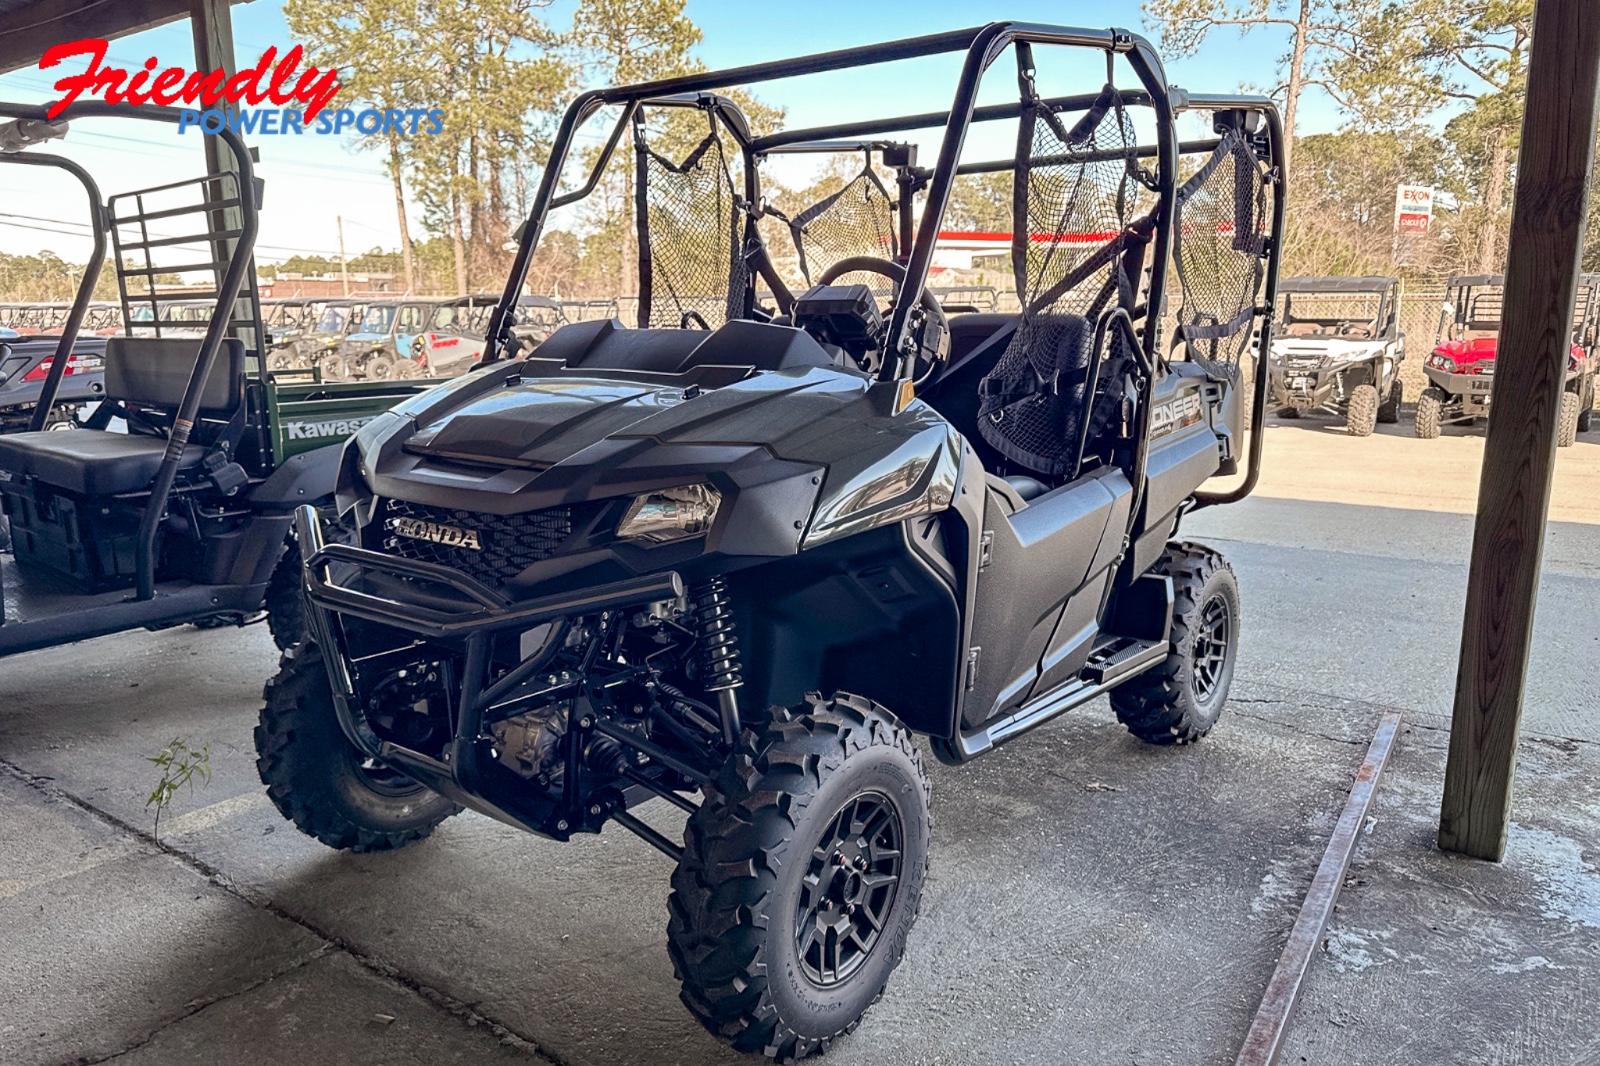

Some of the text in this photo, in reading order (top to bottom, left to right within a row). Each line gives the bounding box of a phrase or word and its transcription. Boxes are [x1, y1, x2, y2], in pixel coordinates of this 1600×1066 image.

[1404, 190, 1429, 204] EXXON
[41, 359, 101, 371] PNEER
[1151, 392, 1200, 426] ONEER
[396, 517, 481, 550] HONDA
[882, 861, 924, 965] KENDA
